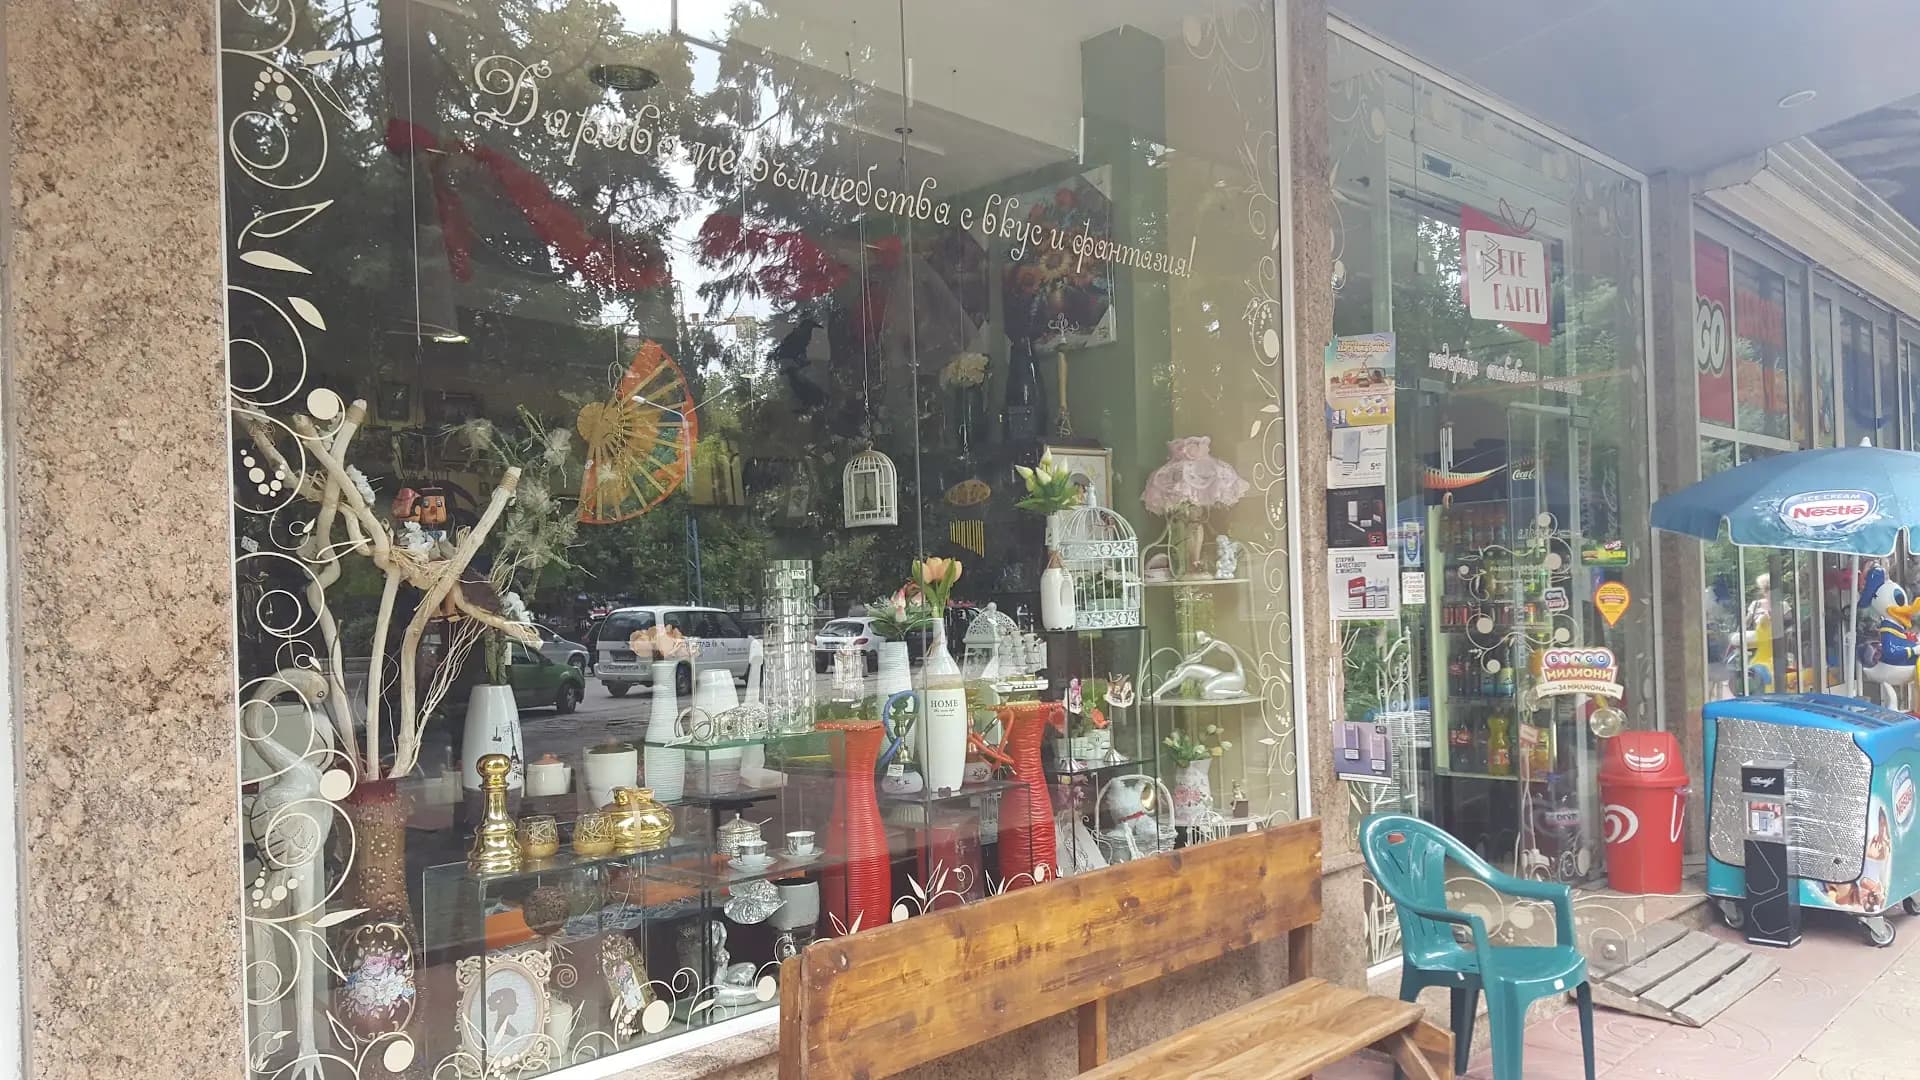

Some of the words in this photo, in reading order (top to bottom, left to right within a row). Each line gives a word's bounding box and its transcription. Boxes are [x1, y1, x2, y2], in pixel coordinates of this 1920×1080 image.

[960, 206, 974, 230] с
[982, 194, 1043, 261] вкус
[1050, 227, 1065, 251] и
[1072, 218, 1197, 279] фантазия!
[1696, 297, 1726, 374] GO
[1803, 494, 1820, 502] ICE
[1546, 668, 1611, 680] МИЛИОНИ
[930, 699, 959, 708] HOME
